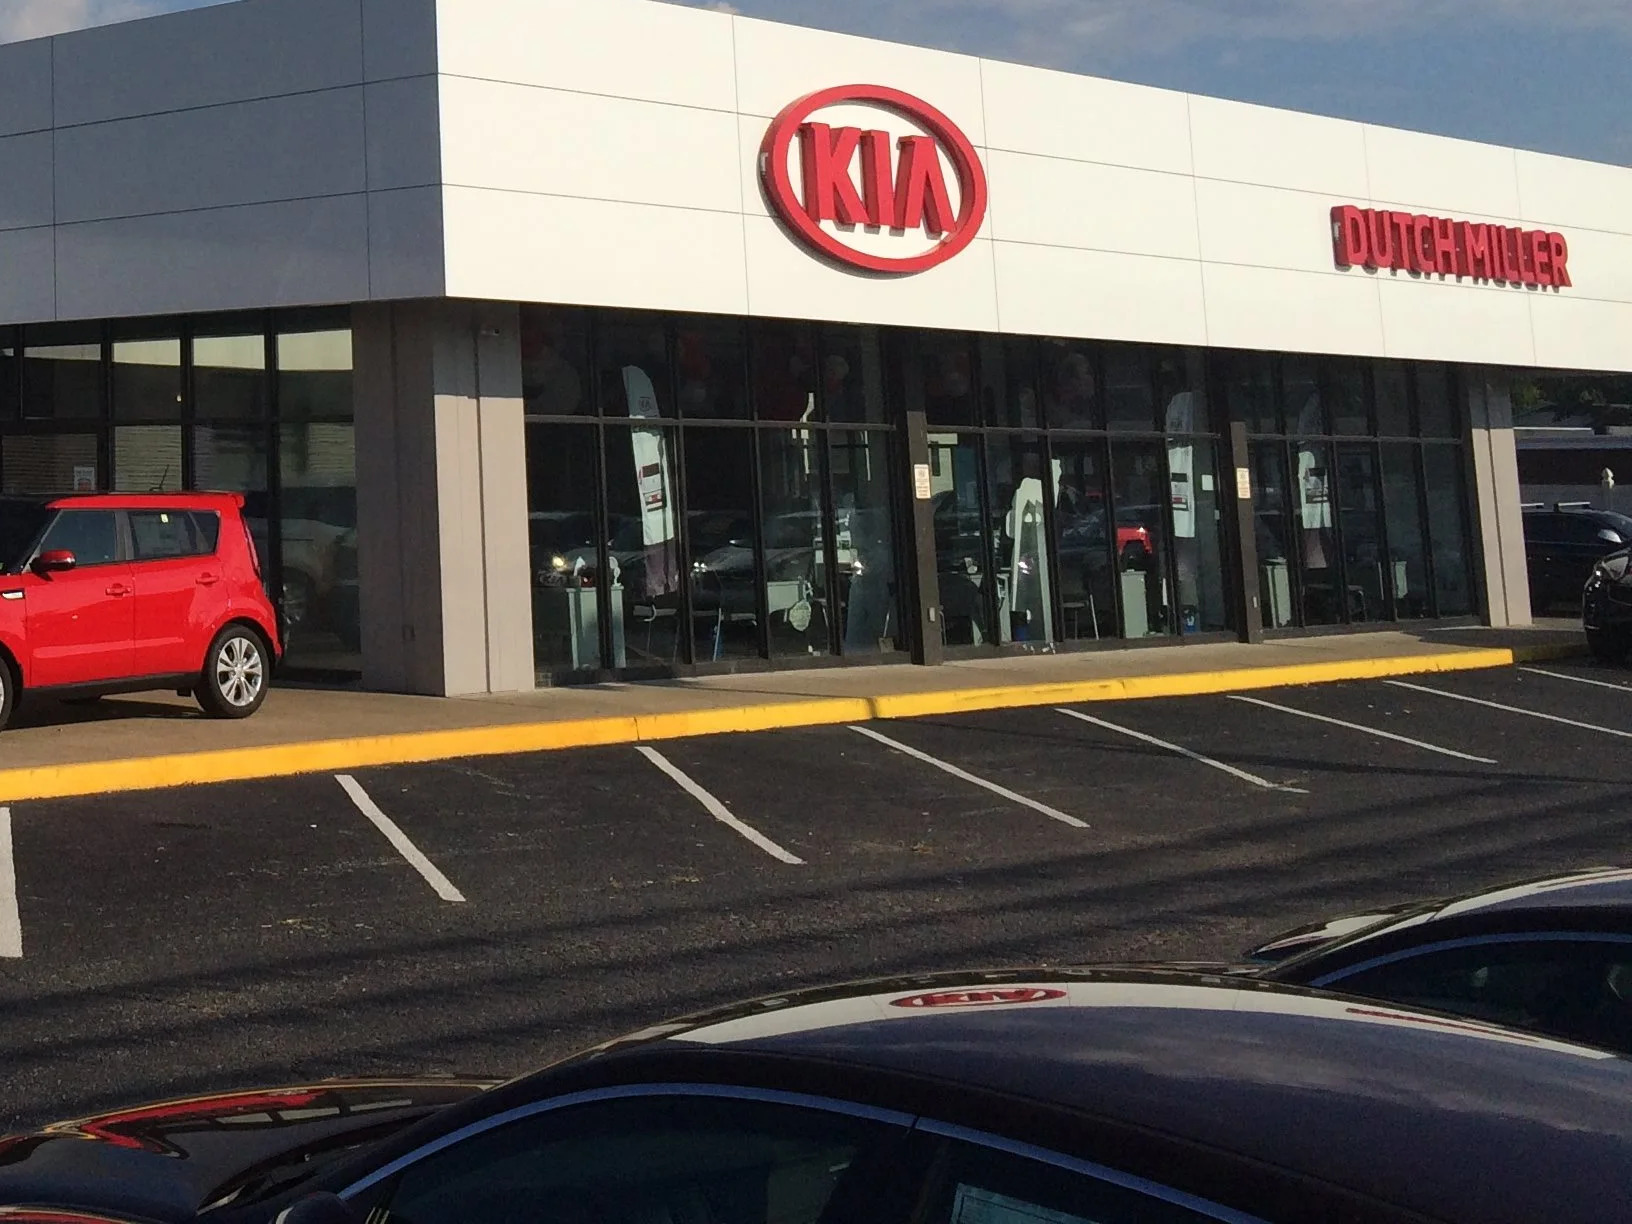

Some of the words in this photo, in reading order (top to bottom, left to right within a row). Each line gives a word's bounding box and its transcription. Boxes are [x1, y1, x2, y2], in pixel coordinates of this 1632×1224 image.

[799, 122, 957, 234] KIA
[1331, 205, 1458, 275] DUTCH
[1462, 221, 1572, 287] MILLER
